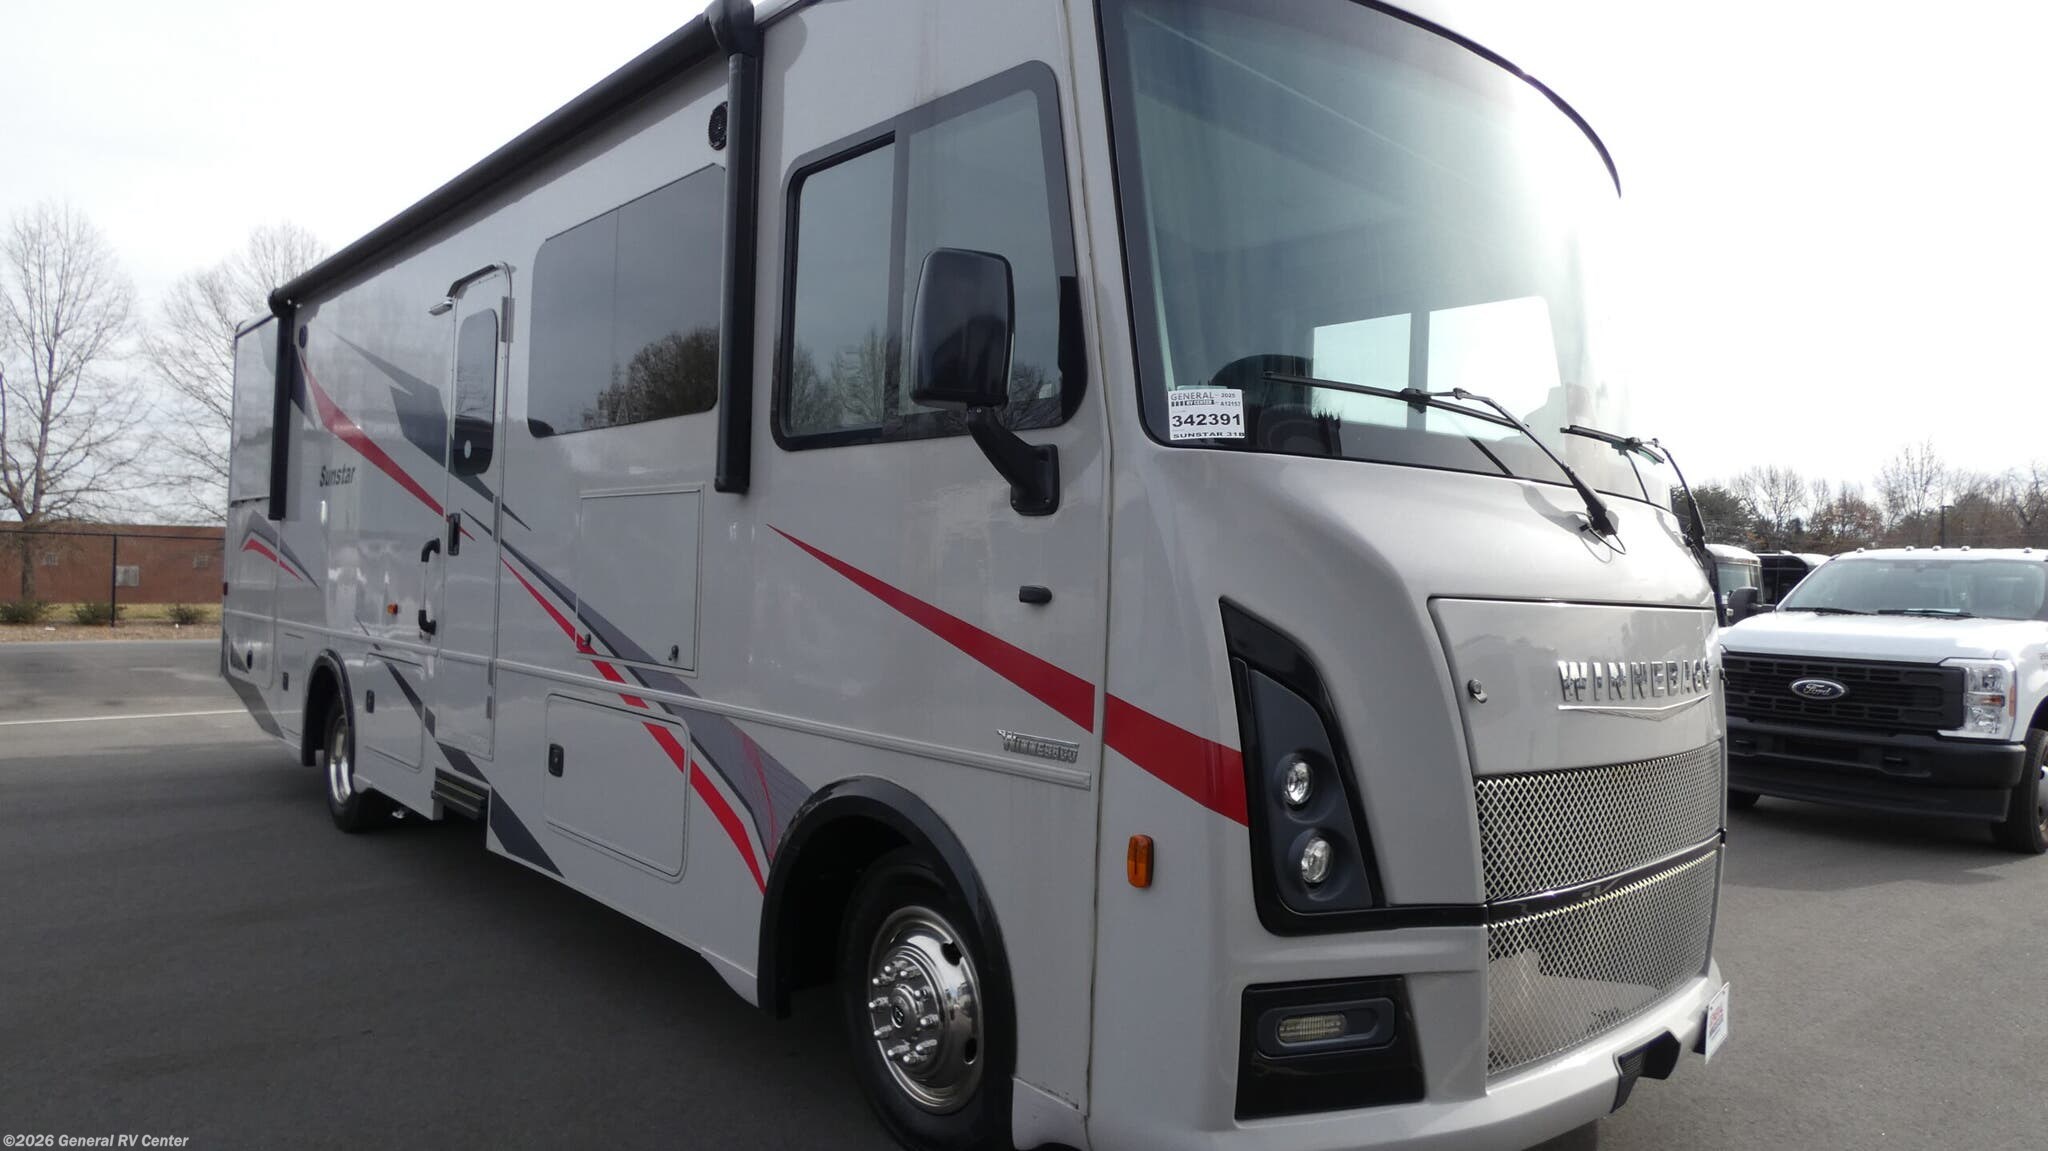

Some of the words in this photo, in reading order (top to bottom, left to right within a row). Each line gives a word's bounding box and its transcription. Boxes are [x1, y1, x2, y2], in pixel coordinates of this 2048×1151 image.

[1171, 392, 1214, 400] GENERAL
[1172, 414, 1241, 427] 342391
[320, 464, 356, 487] Sunstar
[1557, 660, 1711, 702] WINNEBAGO
